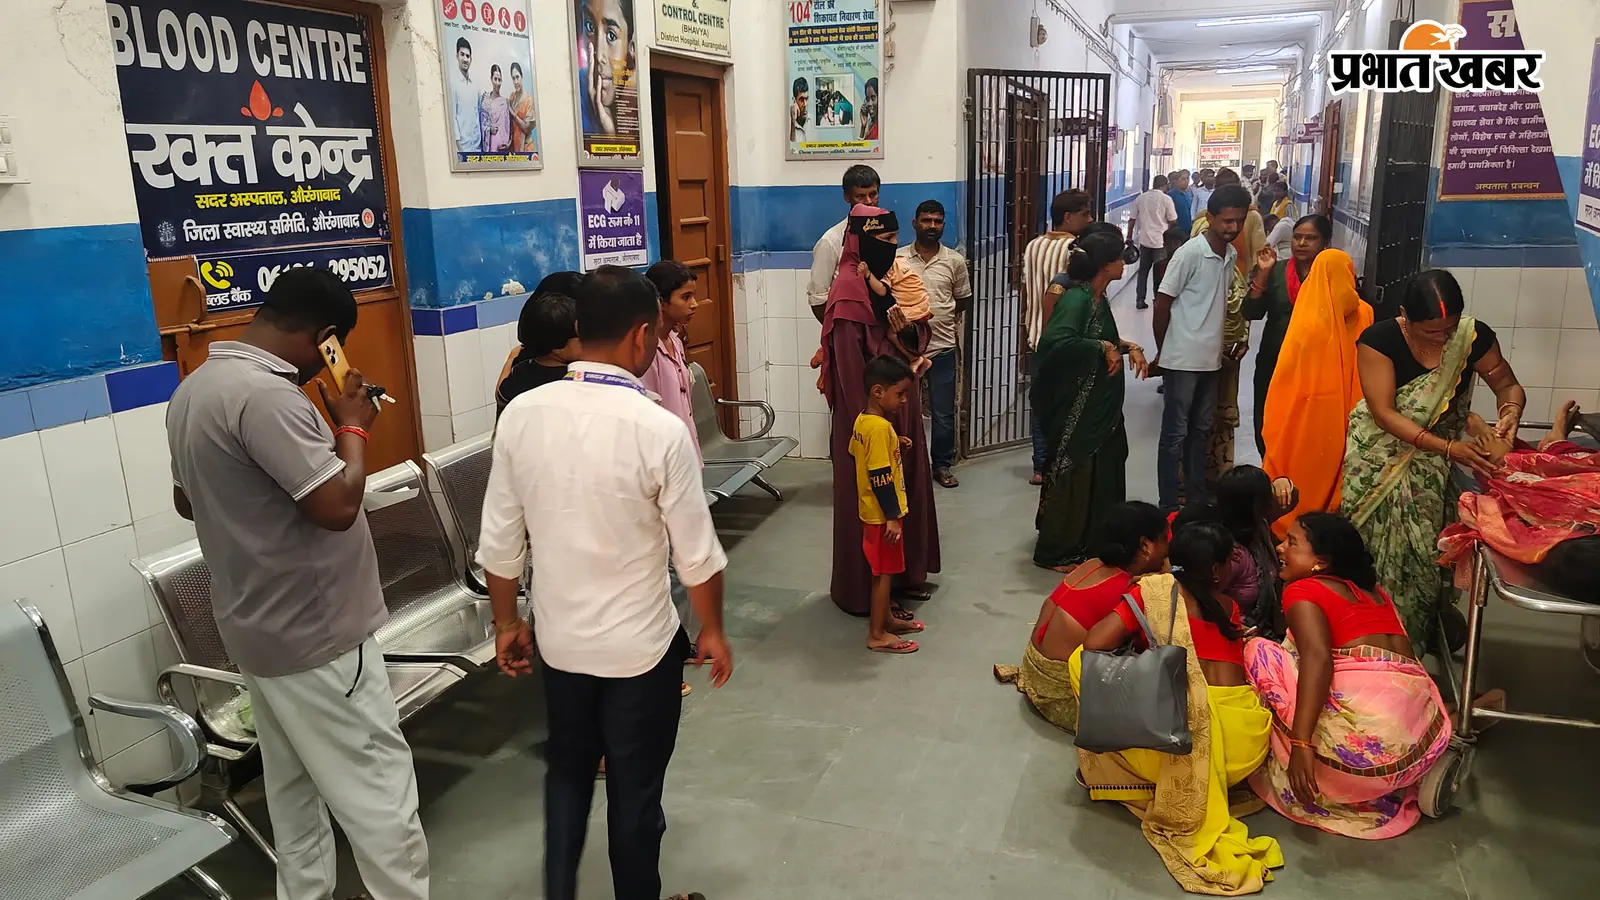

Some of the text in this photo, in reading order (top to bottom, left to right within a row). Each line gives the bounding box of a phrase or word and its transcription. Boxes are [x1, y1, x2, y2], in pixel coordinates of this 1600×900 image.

[662, 5, 724, 28] CONTROL CENTRE
[839, 10, 861, 21] निवारण
[863, 9, 874, 20] सेवा
[682, 24, 709, 38] (BHAVYA)
[110, 2, 367, 84] BLOOD CENTRE
[660, 32, 679, 43] District
[702, 40, 728, 51] Aurangabad
[1509, 101, 1523, 111] और
[1479, 117, 1494, 126] सेवा
[1496, 116, 1505, 125] के
[1505, 116, 1519, 126] लिए
[1509, 130, 1518, 140] से
[126, 103, 374, 193] रक्त केन्द्र
[1530, 145, 1552, 154] देखभा
[1447, 160, 1467, 170] हमारी
[1468, 159, 1505, 169] प्राथमिकता
[1475, 182, 1508, 190] अस्पताल
[195, 185, 341, 209] सदर अस्पताल, औरंगाबाद
[183, 210, 360, 242] जिला स्वास्थ्य समिति, औरंगाबाद
[588, 214, 606, 228] ECG
[608, 217, 622, 227] रूम
[634, 215, 640, 226] 11
[588, 232, 642, 249] में किया जाता है
